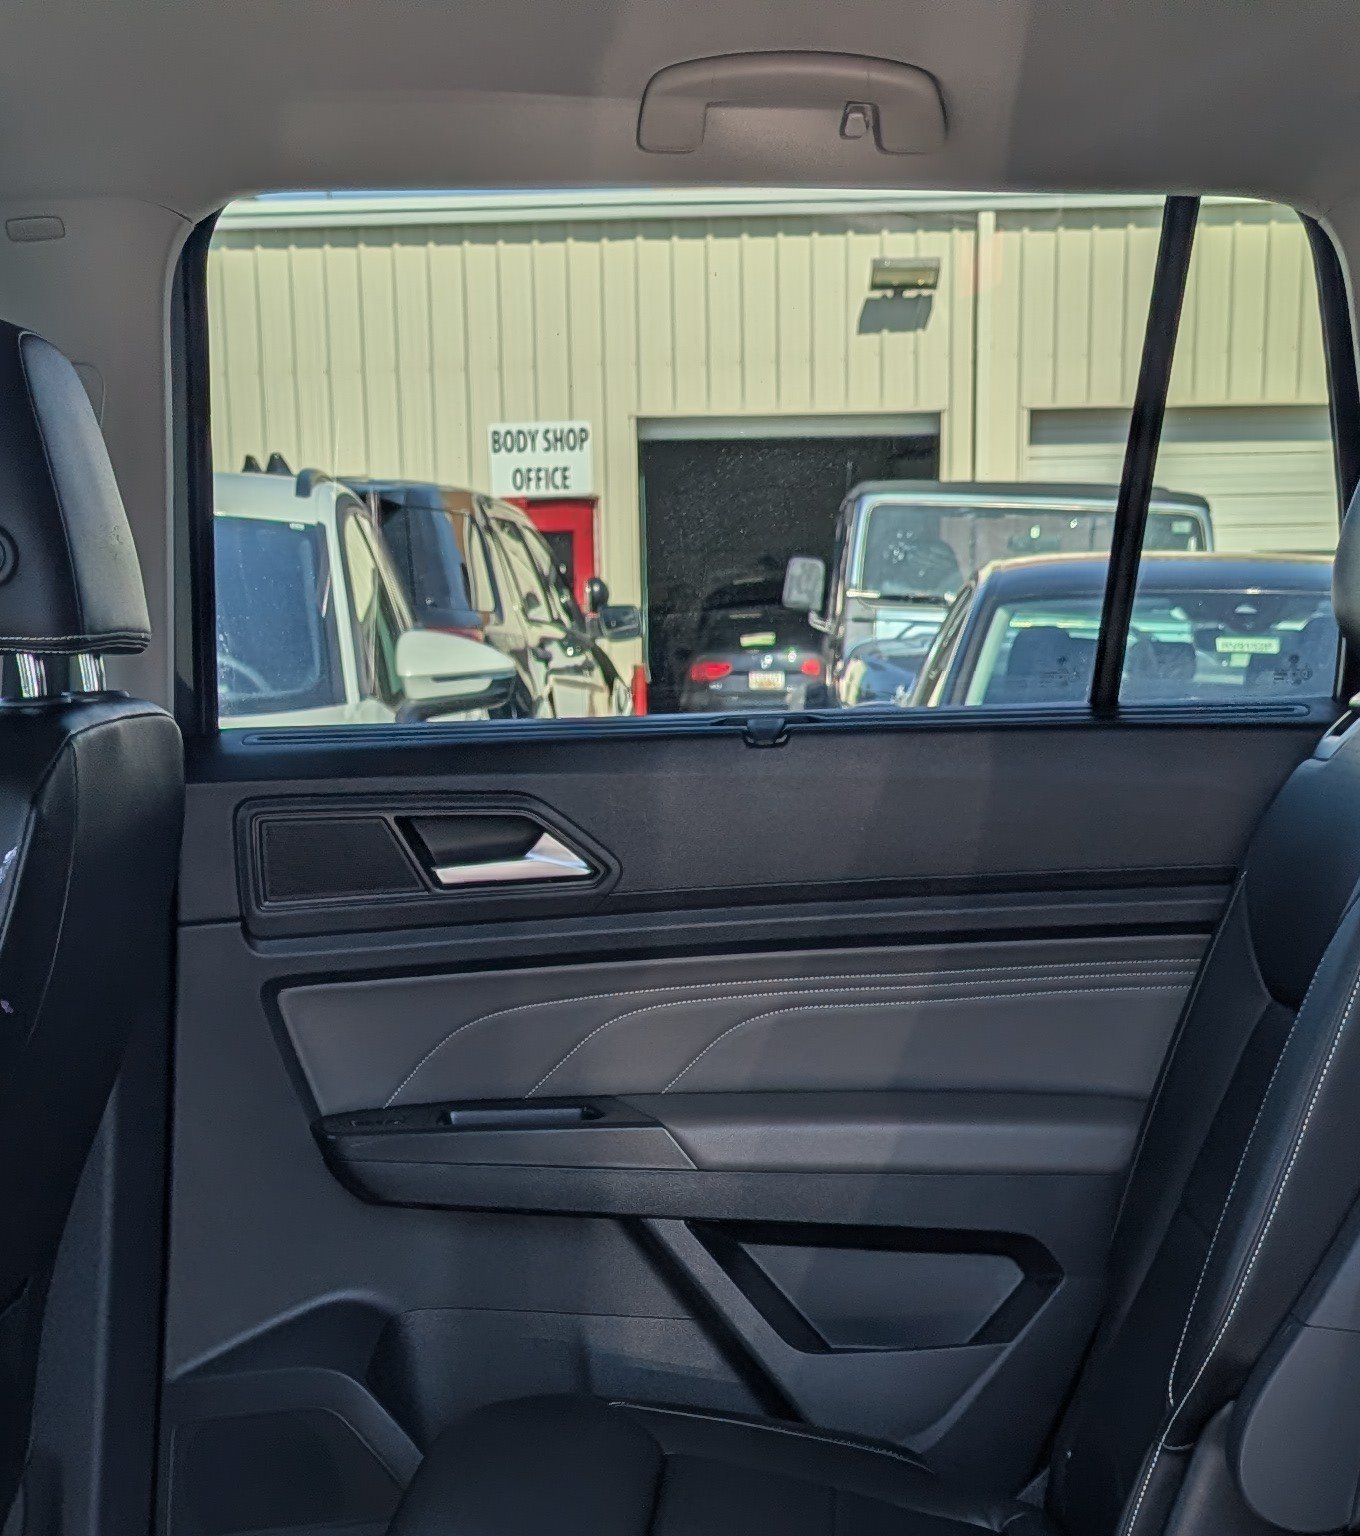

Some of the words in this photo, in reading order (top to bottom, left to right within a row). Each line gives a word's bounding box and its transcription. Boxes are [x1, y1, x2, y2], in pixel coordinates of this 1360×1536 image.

[492, 429, 538, 453] BODY
[542, 427, 589, 451] SHOP
[512, 466, 570, 491] OFFICE
